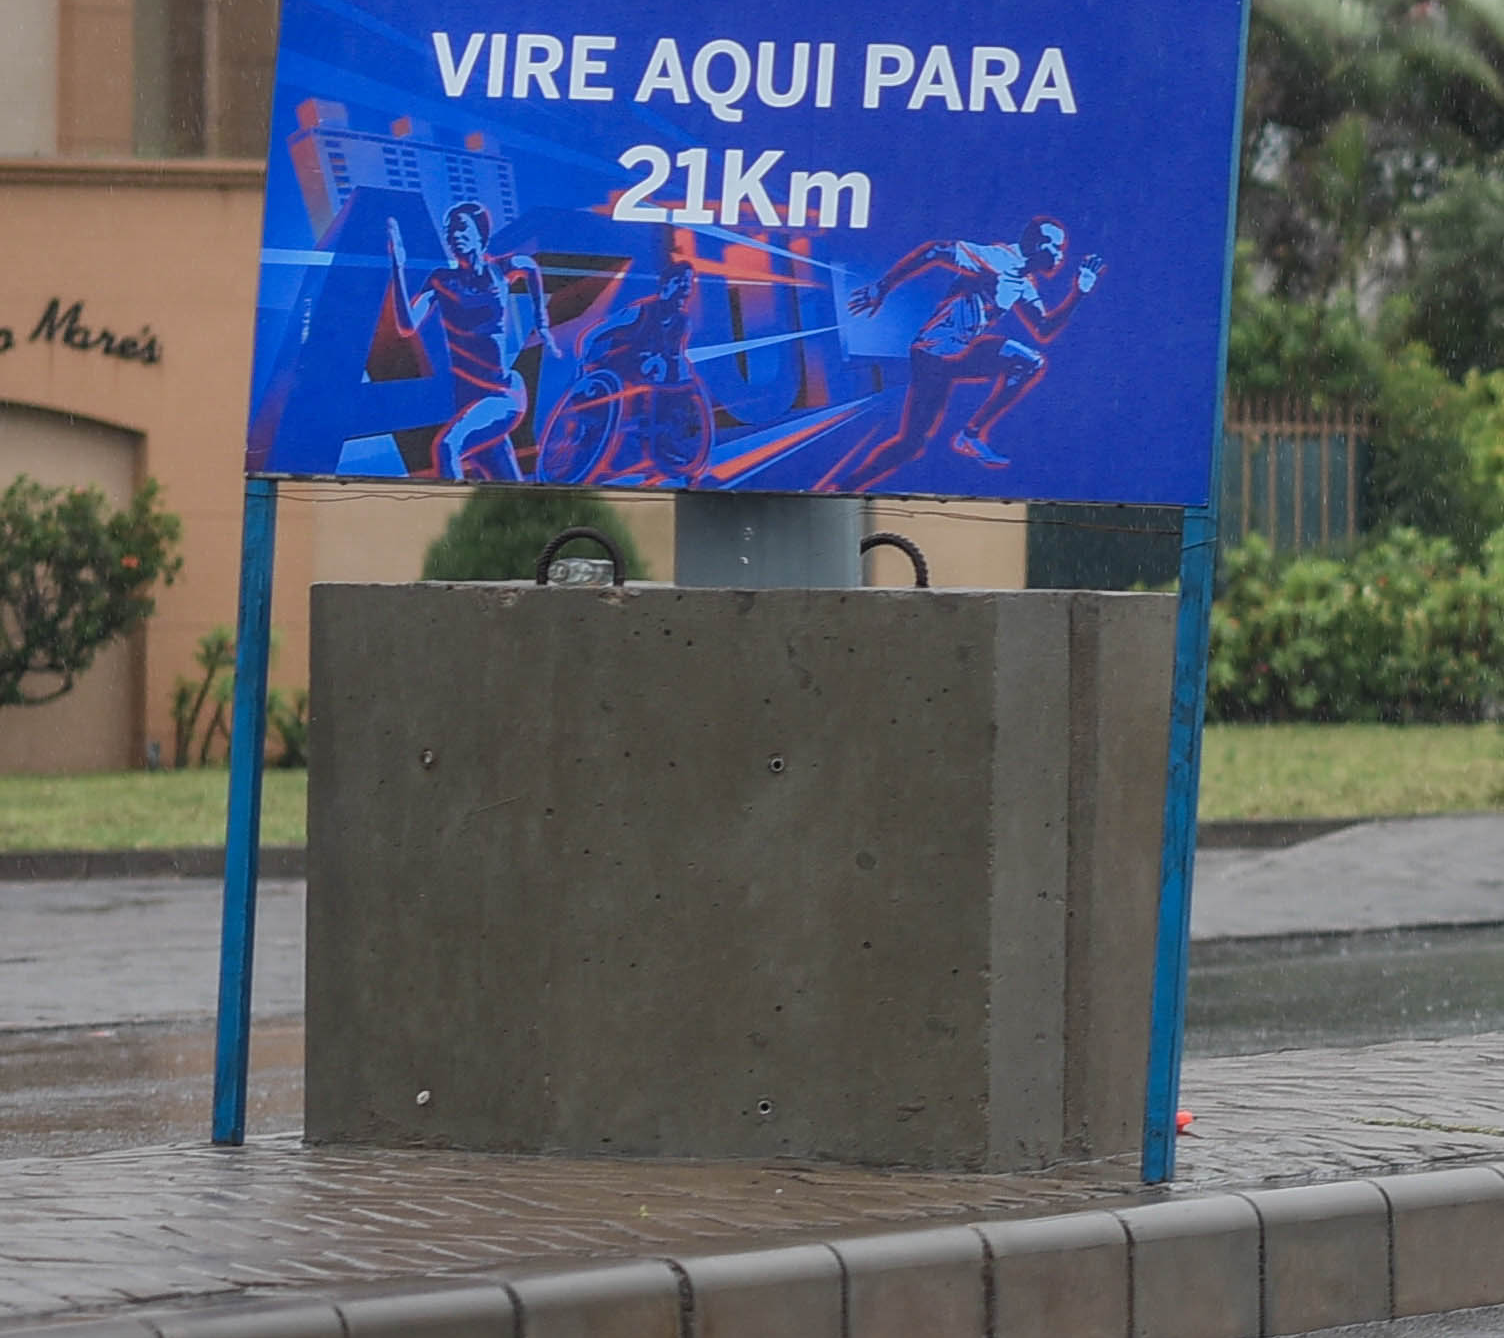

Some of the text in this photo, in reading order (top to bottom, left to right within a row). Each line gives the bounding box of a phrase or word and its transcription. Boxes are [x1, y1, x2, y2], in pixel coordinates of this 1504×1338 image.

[432, 32, 1077, 123] VIRE AQUI PARA
[612, 145, 871, 229] 21Km
